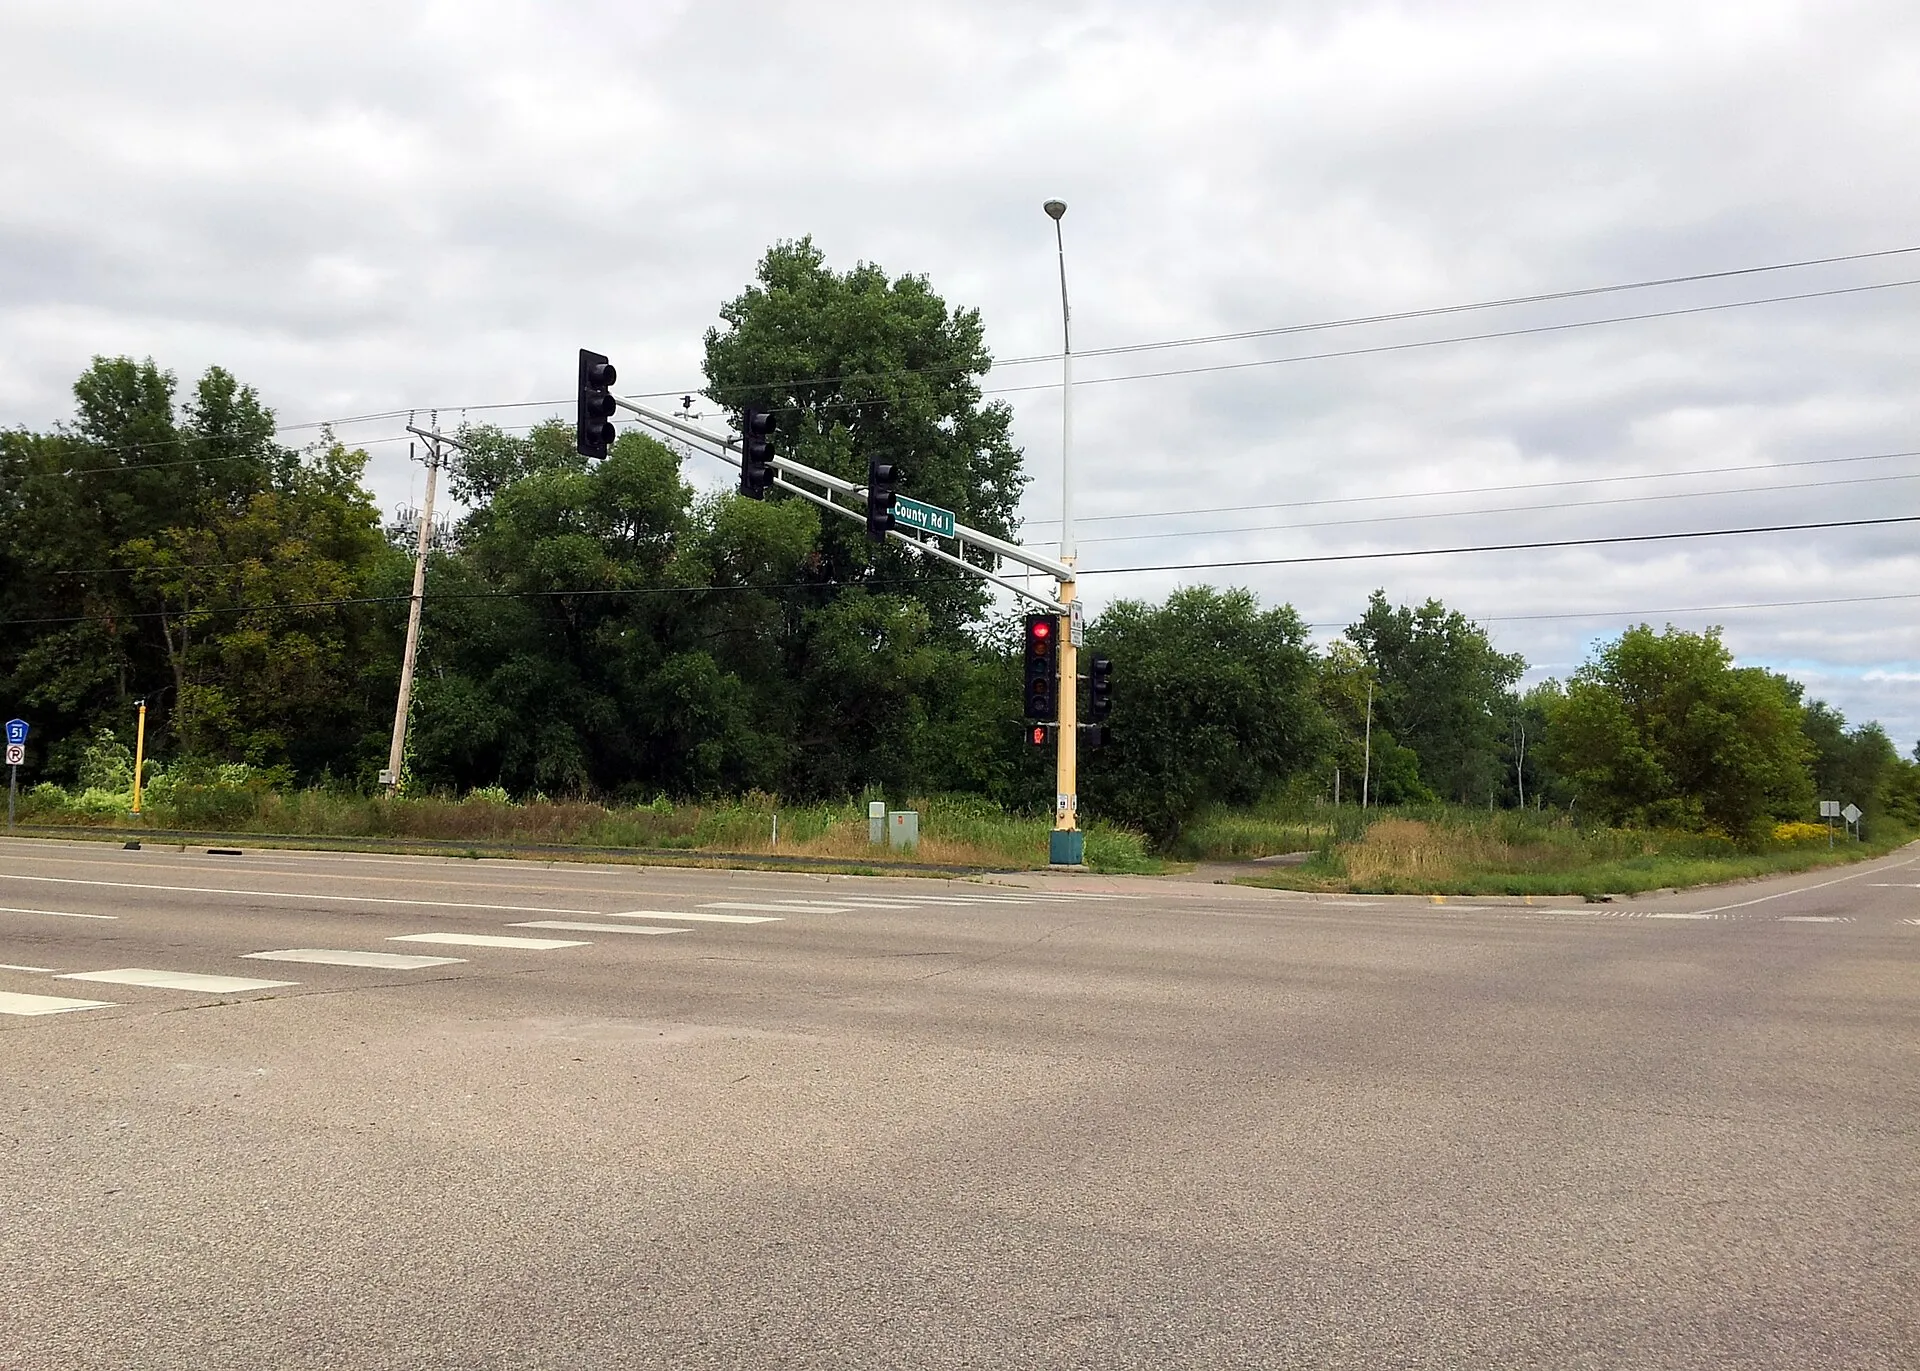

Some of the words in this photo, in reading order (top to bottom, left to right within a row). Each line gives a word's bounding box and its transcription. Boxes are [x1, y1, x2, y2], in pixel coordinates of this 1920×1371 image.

[895, 501, 927, 527] County
[931, 512, 942, 528] Rd
[11, 727, 22, 738] 51
